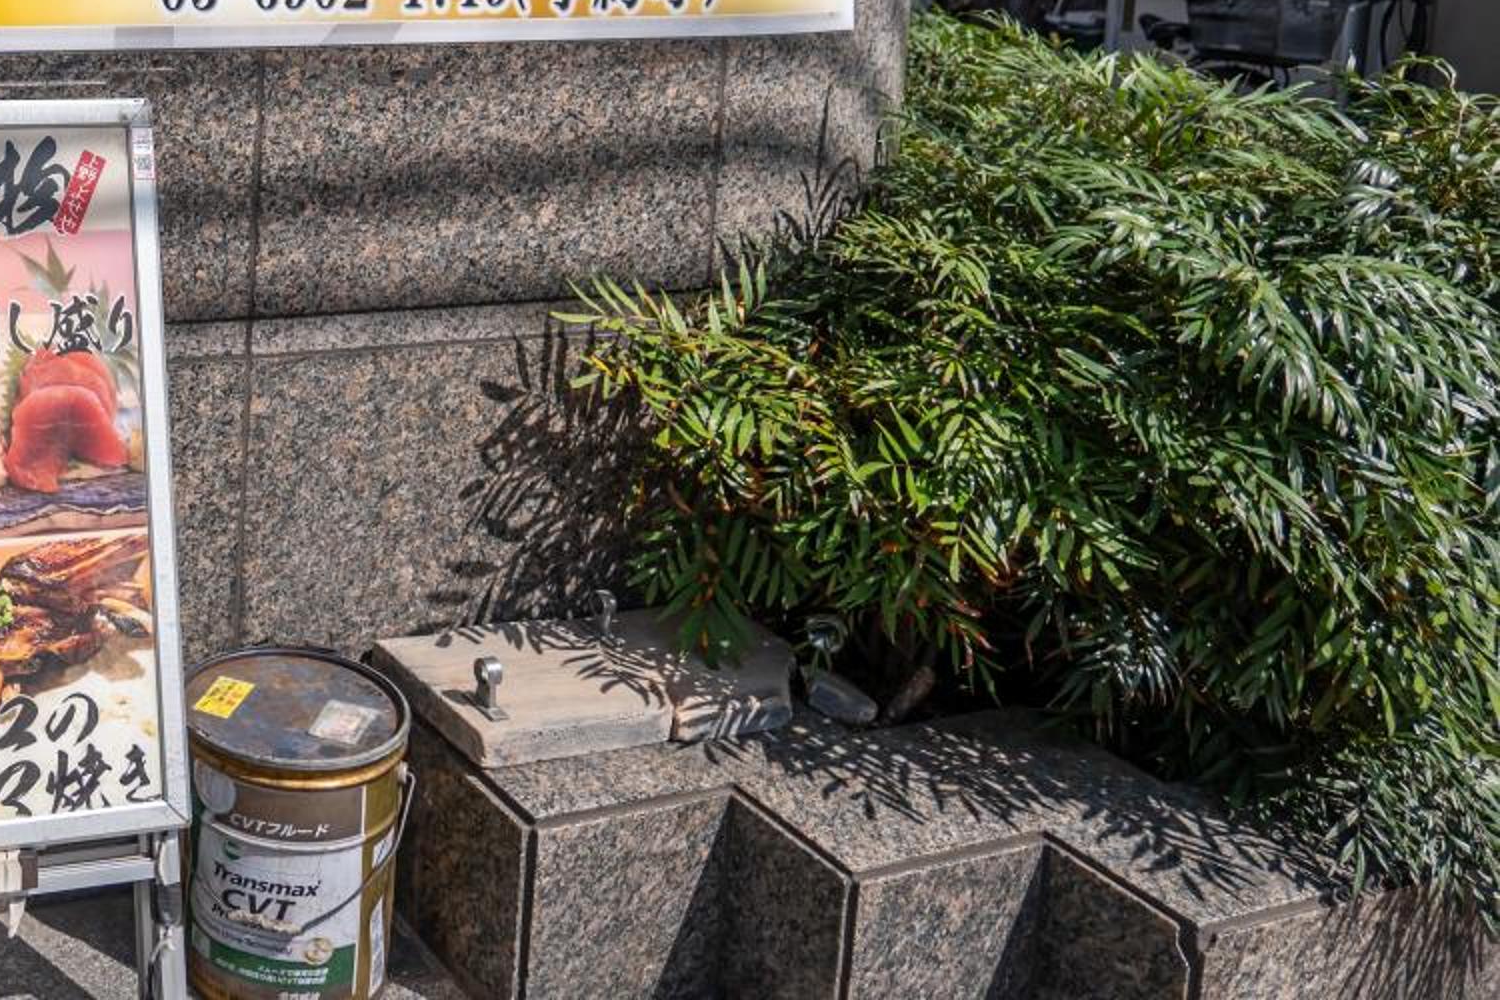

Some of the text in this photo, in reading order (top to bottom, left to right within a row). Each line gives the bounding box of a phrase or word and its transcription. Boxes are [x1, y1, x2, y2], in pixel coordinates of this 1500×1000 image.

[230, 812, 331, 838] CVTフルード
[214, 860, 320, 898] Transmax
[222, 889, 296, 922] CVT
